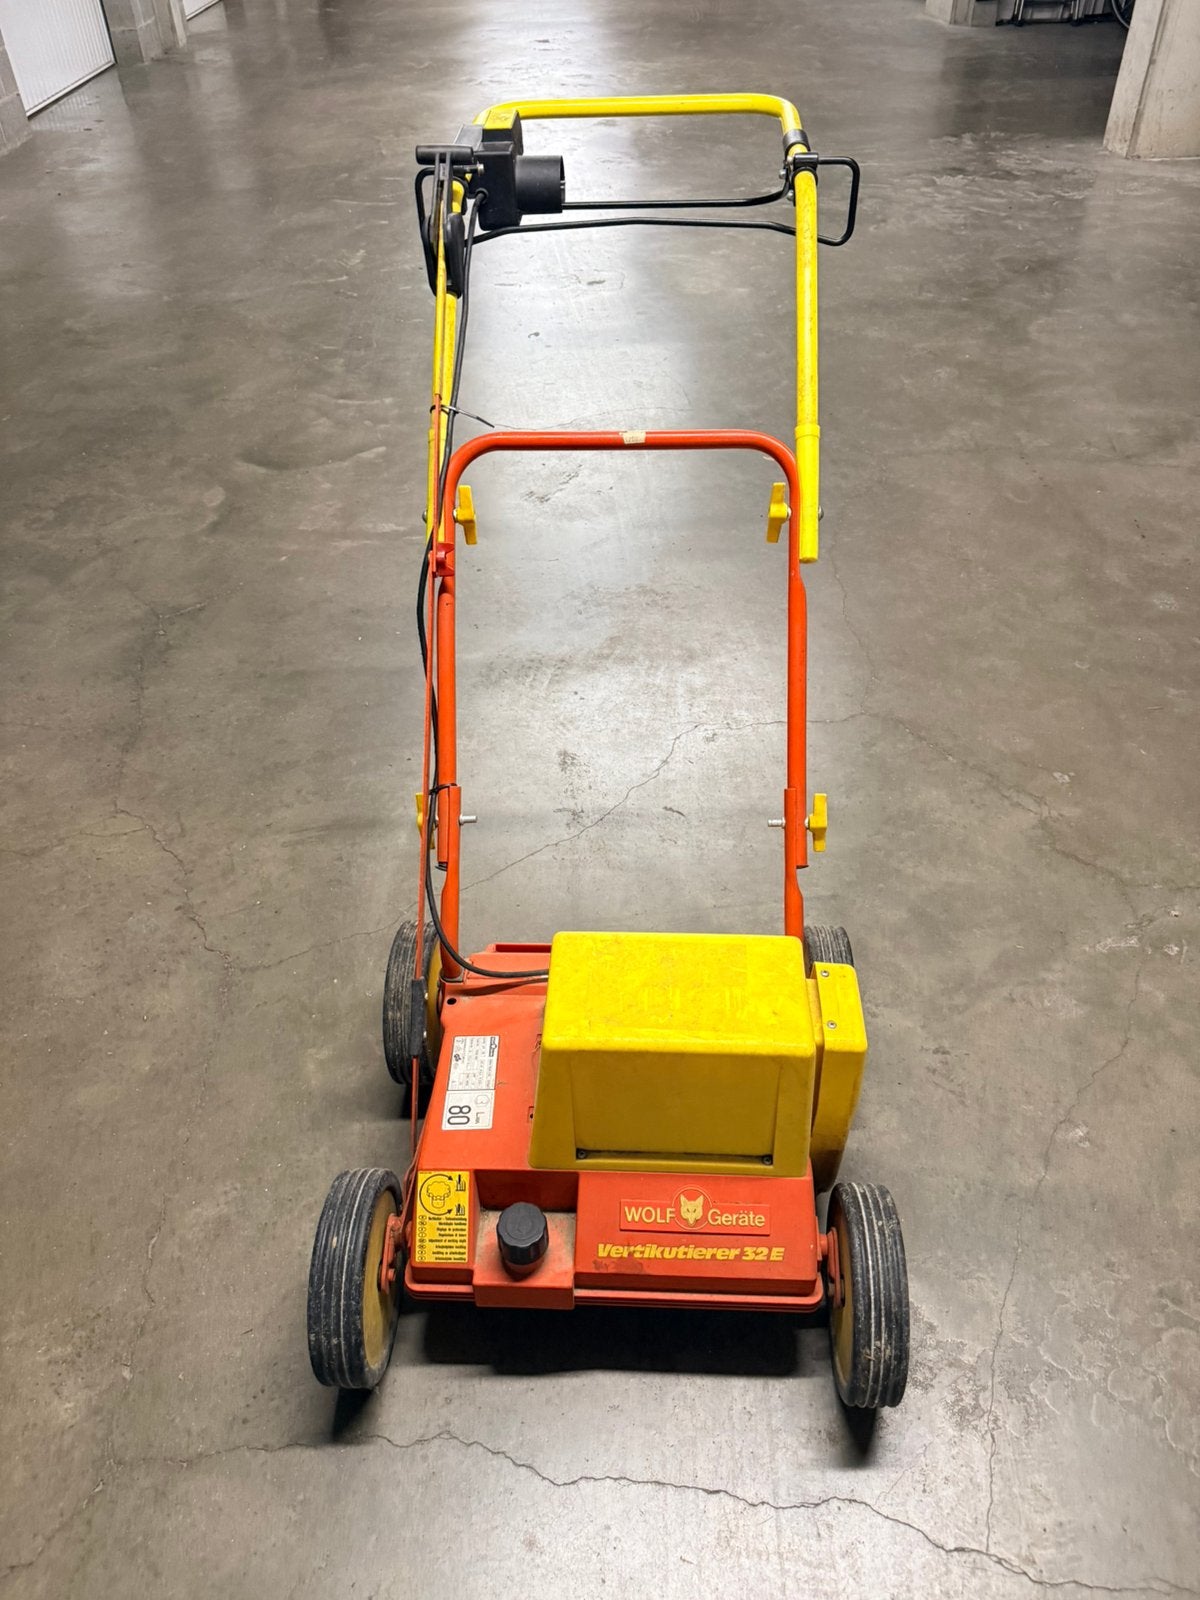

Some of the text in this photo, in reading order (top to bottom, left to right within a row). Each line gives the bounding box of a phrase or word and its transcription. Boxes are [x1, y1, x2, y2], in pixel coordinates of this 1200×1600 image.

[447, 1105, 472, 1125] 80
[624, 1206, 765, 1227] WOLF Geräte
[597, 1243, 785, 1261] Vertikutierer 32 E
